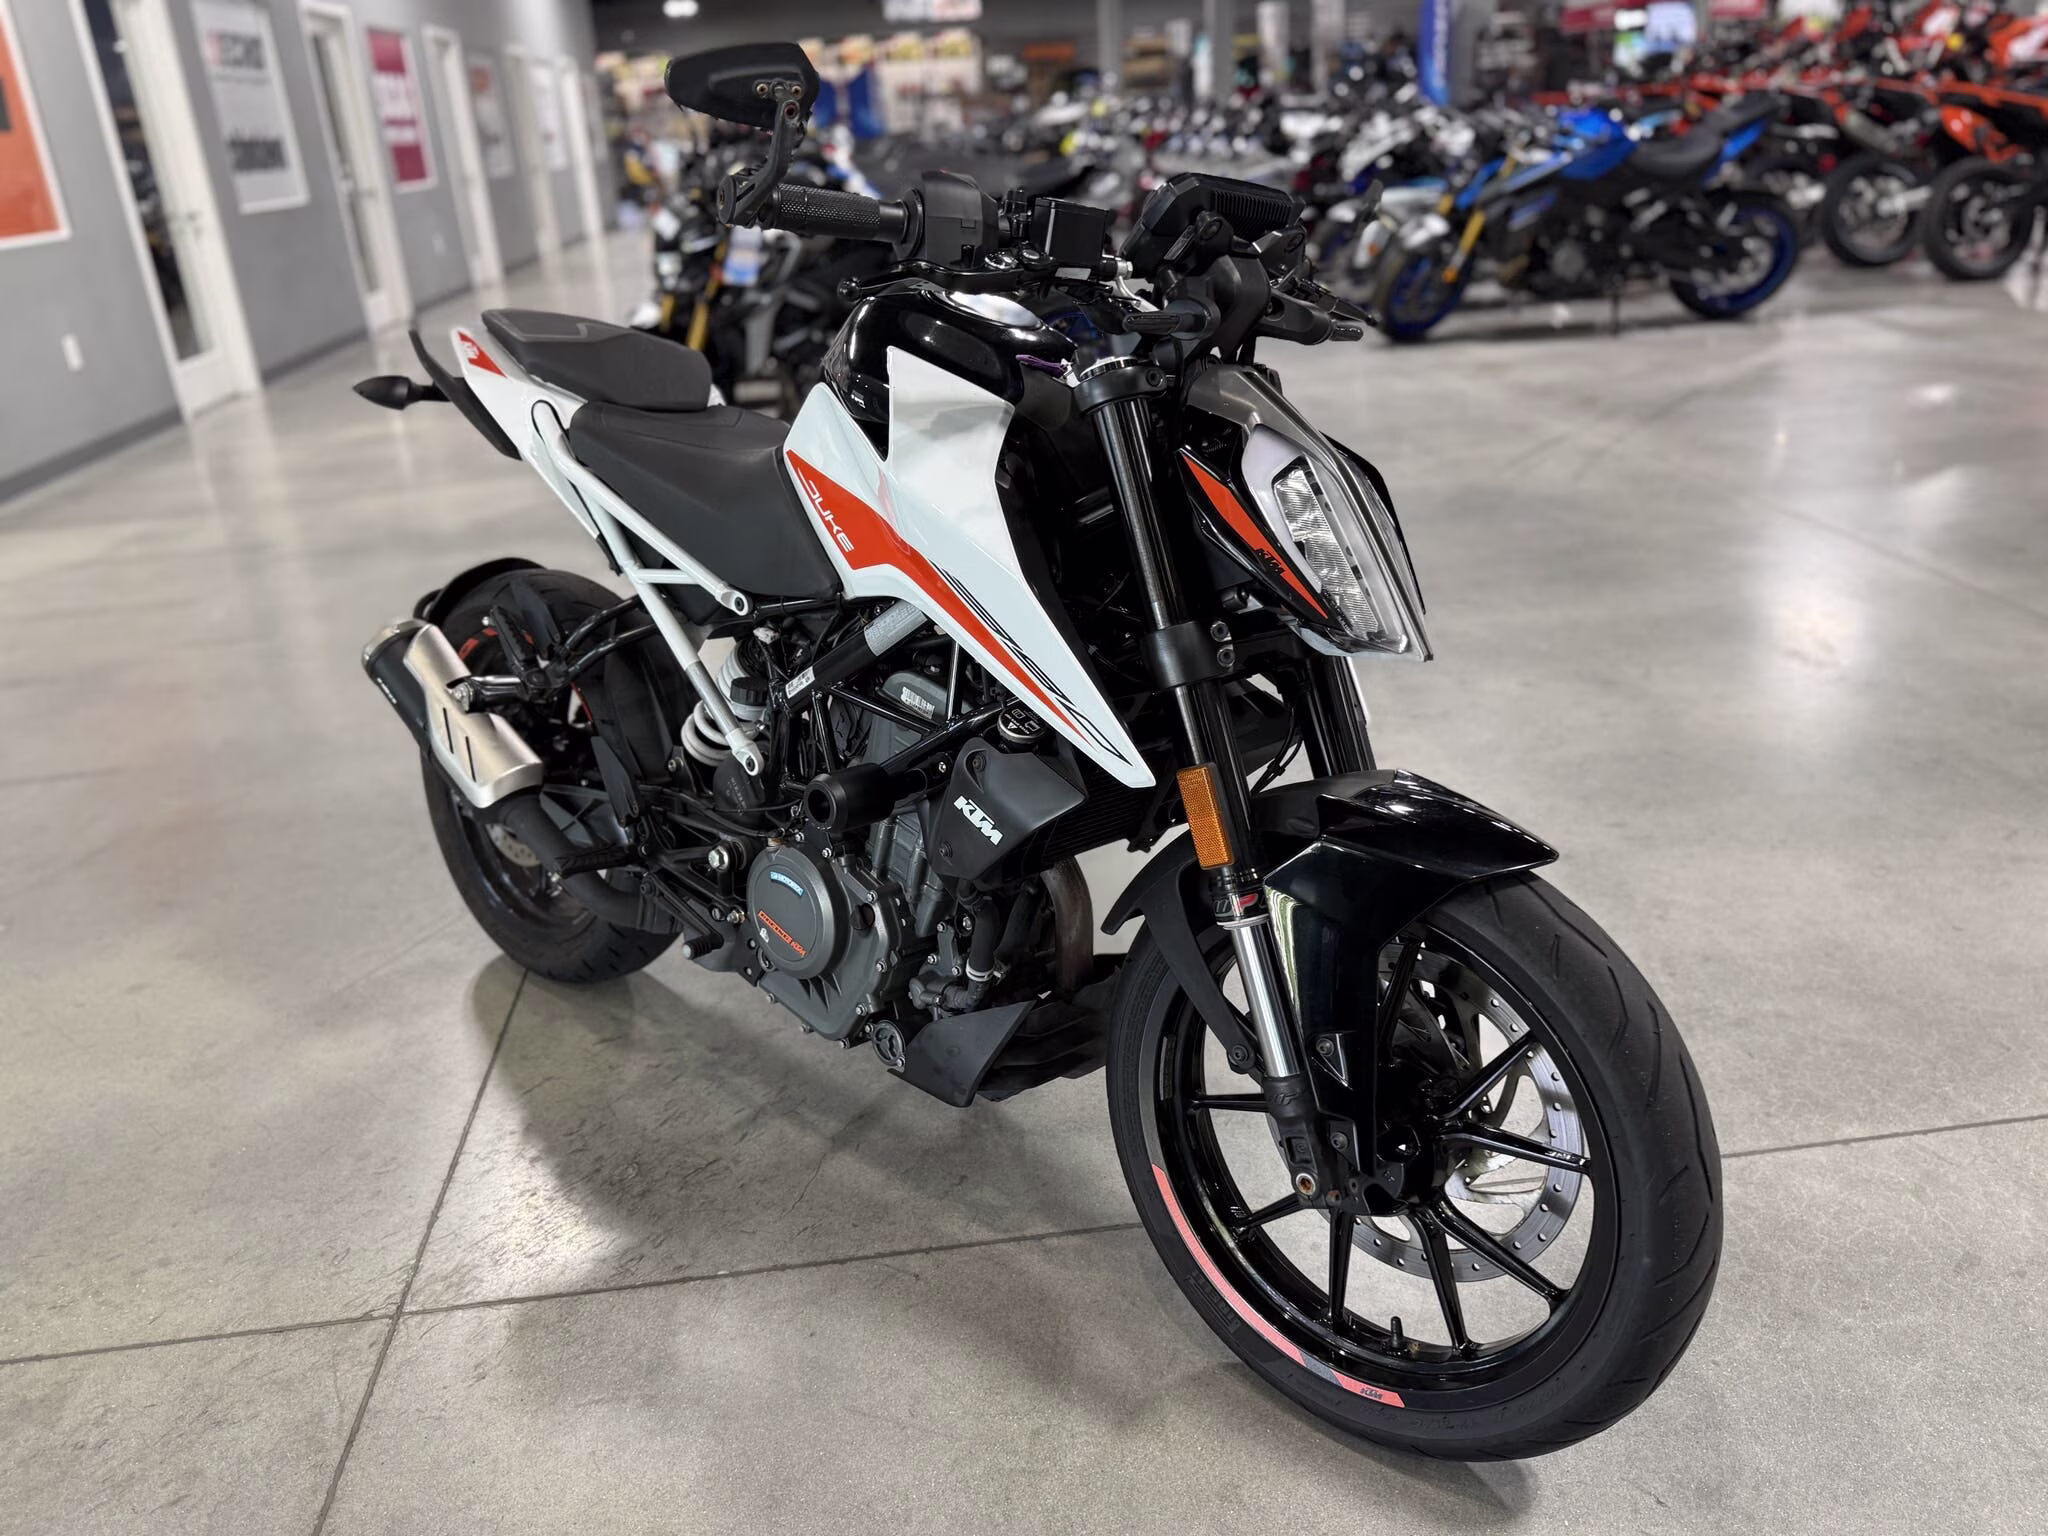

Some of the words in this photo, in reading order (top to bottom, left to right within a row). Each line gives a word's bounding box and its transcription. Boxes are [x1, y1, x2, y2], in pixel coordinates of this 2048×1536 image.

[798, 467, 855, 553] DUKE
[1254, 547, 1286, 576] KTM
[953, 795, 1003, 846] KTM
[1360, 1387, 1383, 1401] KTM
